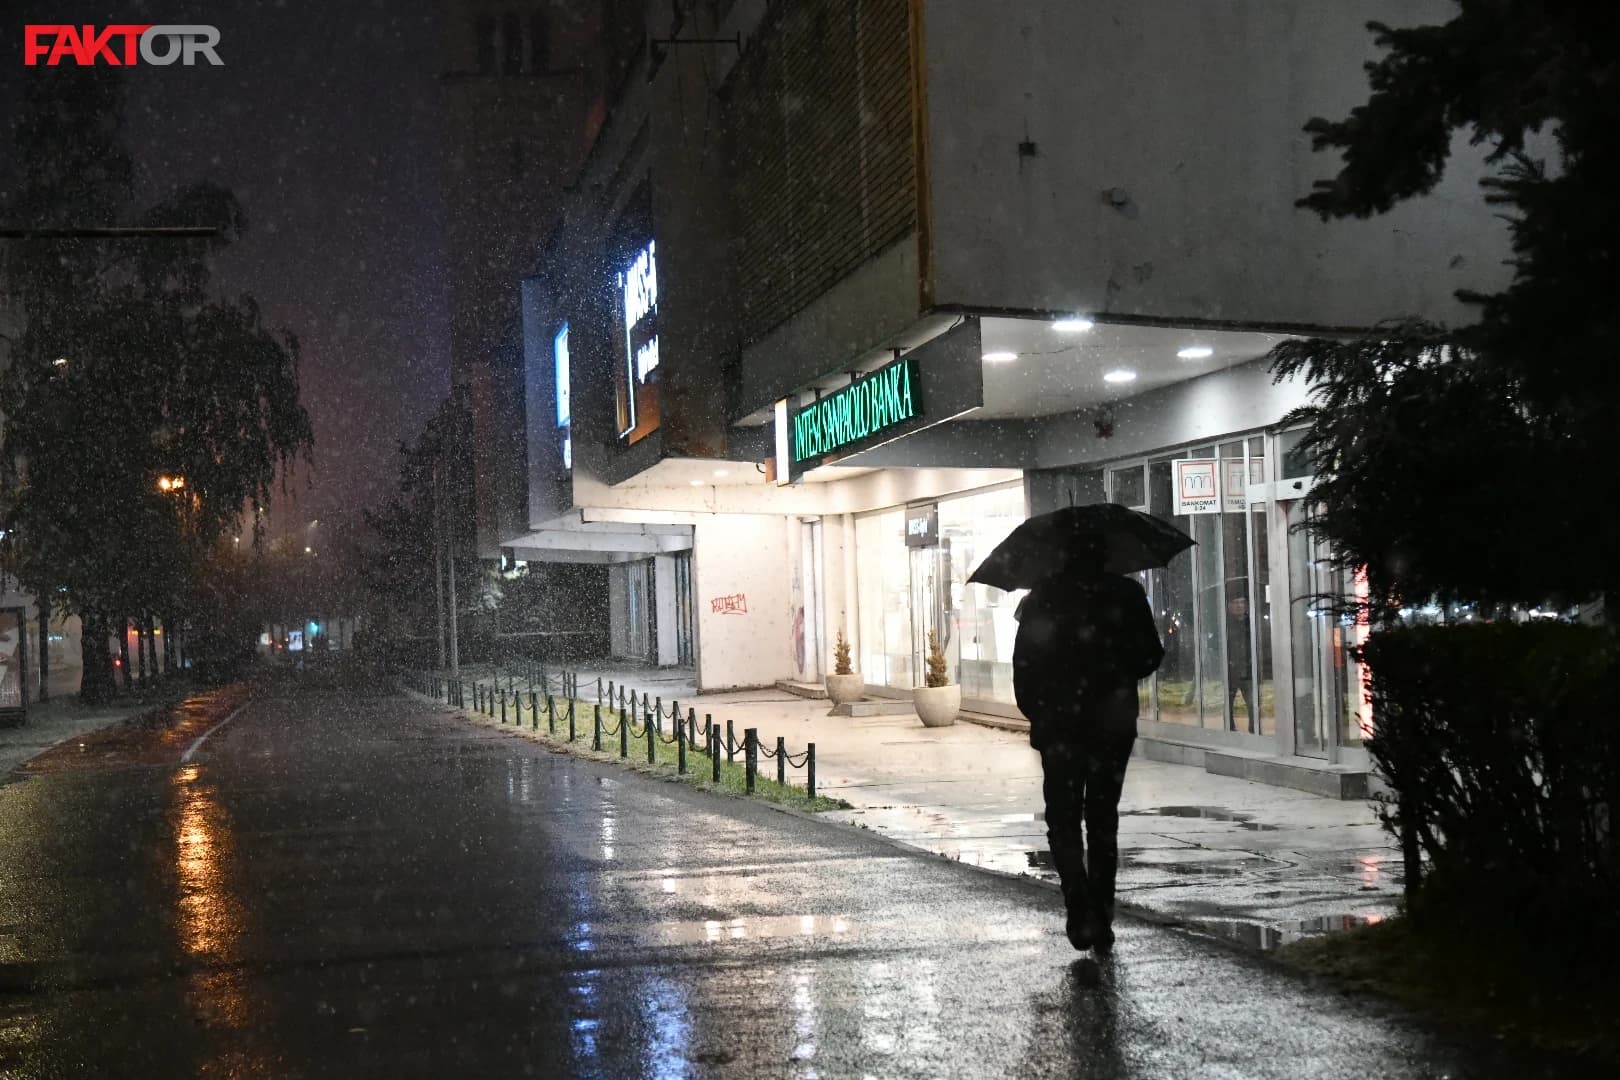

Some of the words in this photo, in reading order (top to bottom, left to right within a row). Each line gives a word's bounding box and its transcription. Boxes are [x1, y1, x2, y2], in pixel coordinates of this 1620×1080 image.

[794, 402, 822, 462] INTESA
[822, 380, 870, 452] SANPAOLO
[871, 359, 913, 432] BANKA
